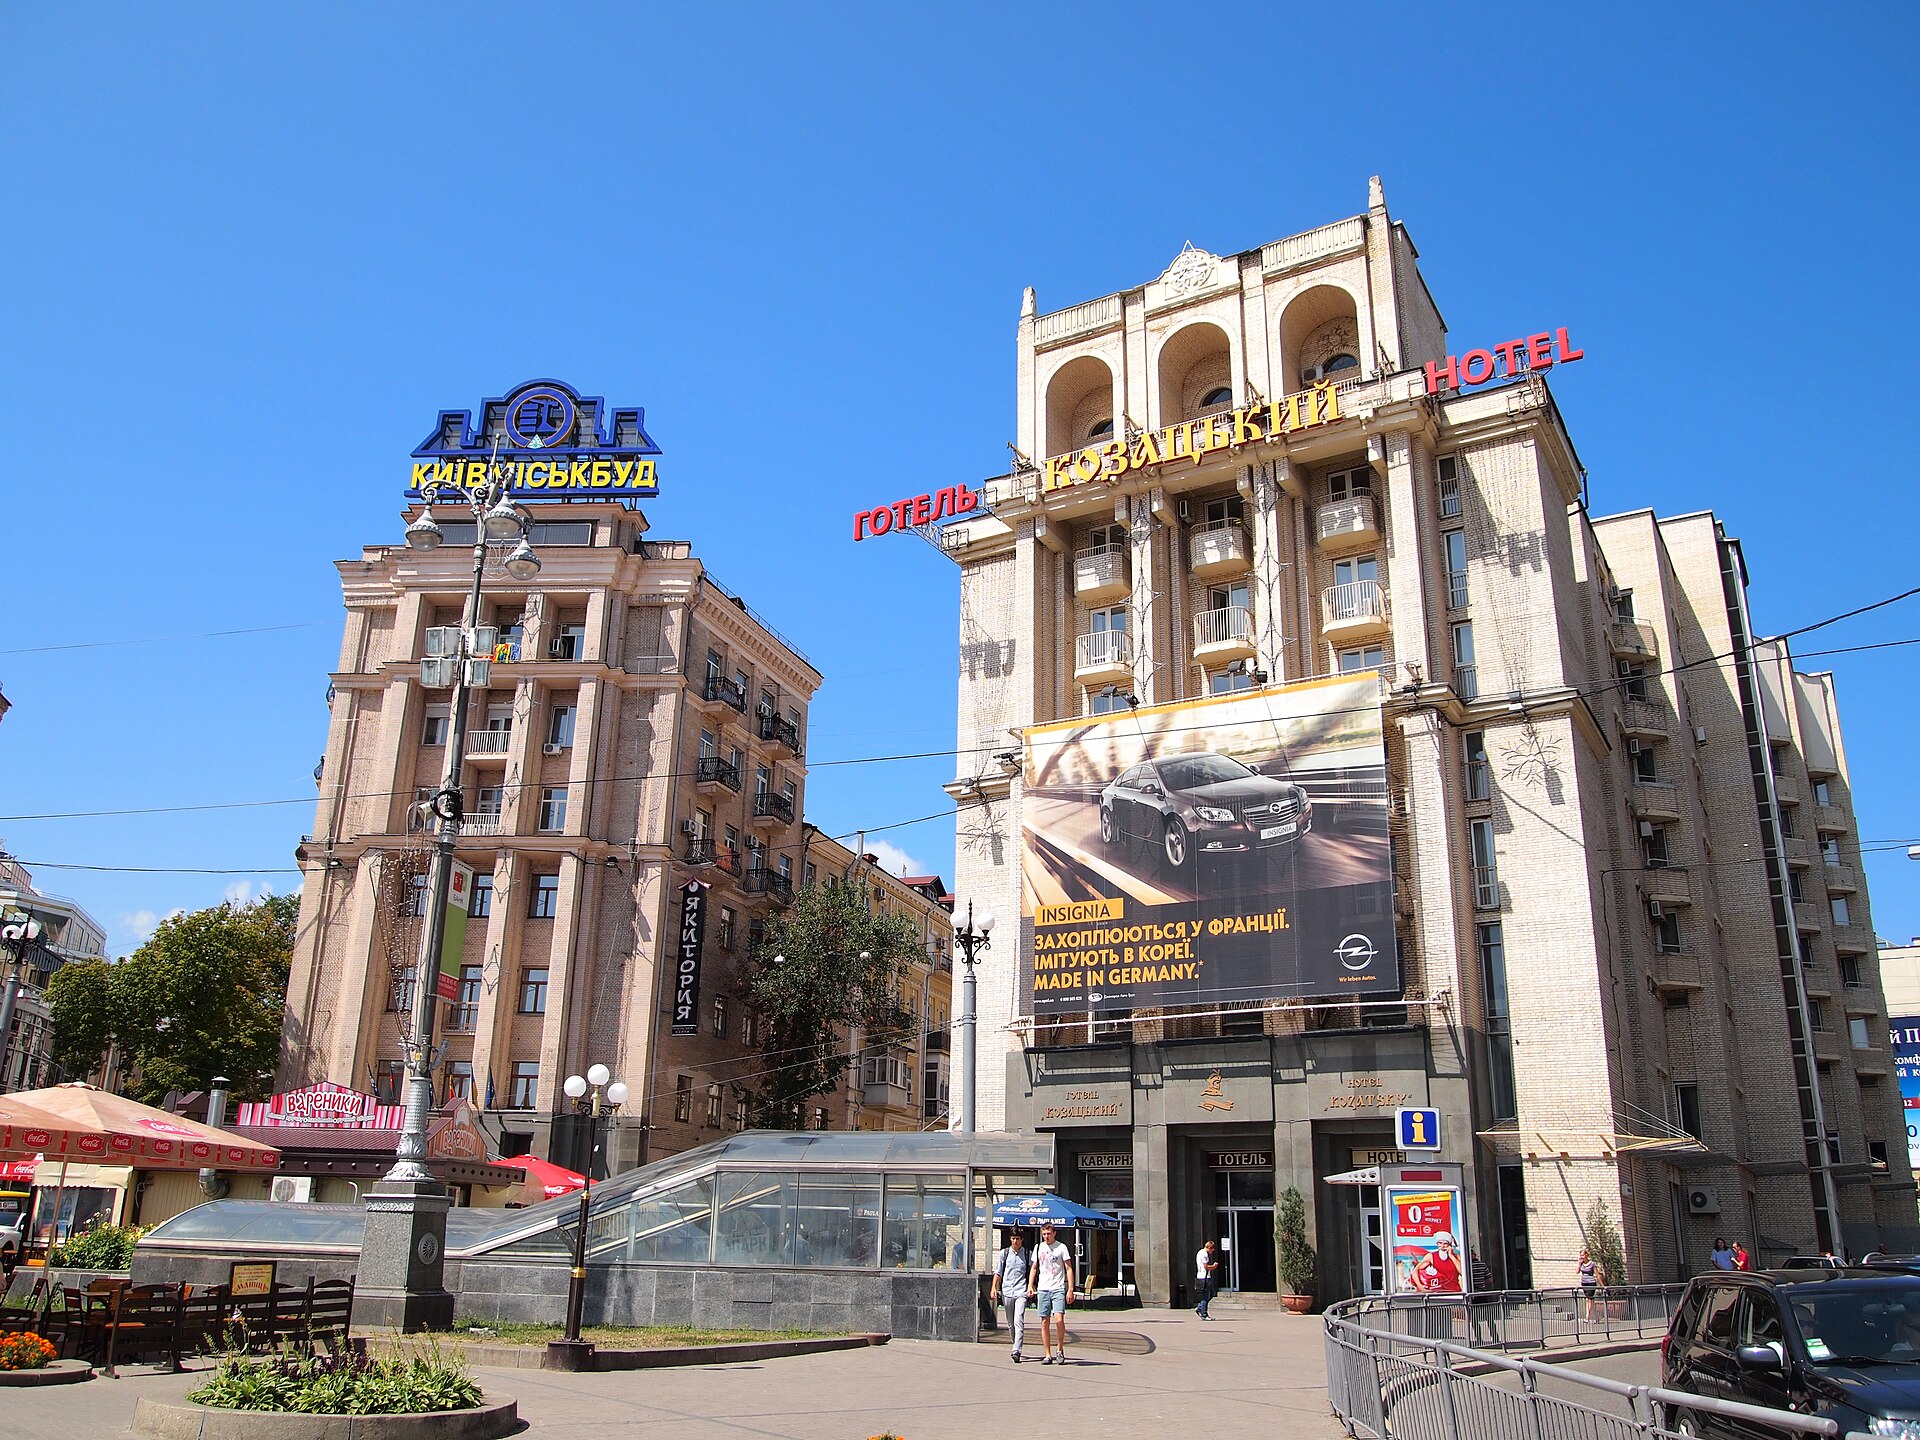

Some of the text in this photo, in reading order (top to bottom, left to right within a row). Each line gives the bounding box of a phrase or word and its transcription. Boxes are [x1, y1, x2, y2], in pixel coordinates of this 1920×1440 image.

[1425, 326, 1584, 396] HOTEL
[1044, 378, 1343, 492] КОЗАЦЬКИЙ
[853, 483, 978, 541] ГОТЕЛЬ
[1267, 825, 1293, 836] INSIGNIA
[1042, 903, 1110, 923] INSIGNIA
[1034, 907, 1290, 950] ЗАХОПЛЮЮТЬСЯ У ФРАНЦІЇ.
[676, 897, 700, 1020] ЯКИТОРИЯ
[1034, 938, 1194, 970] ІМІТУЮТЬ В КОРЕЇ.
[1033, 971, 1082, 990] MADE
[1087, 970, 1104, 987] IN
[1347, 1077, 1382, 1088] HOTEL
[1218, 1153, 1266, 1165] ГОТЕЛЬ
[1408, 1205, 1422, 1224] 0
